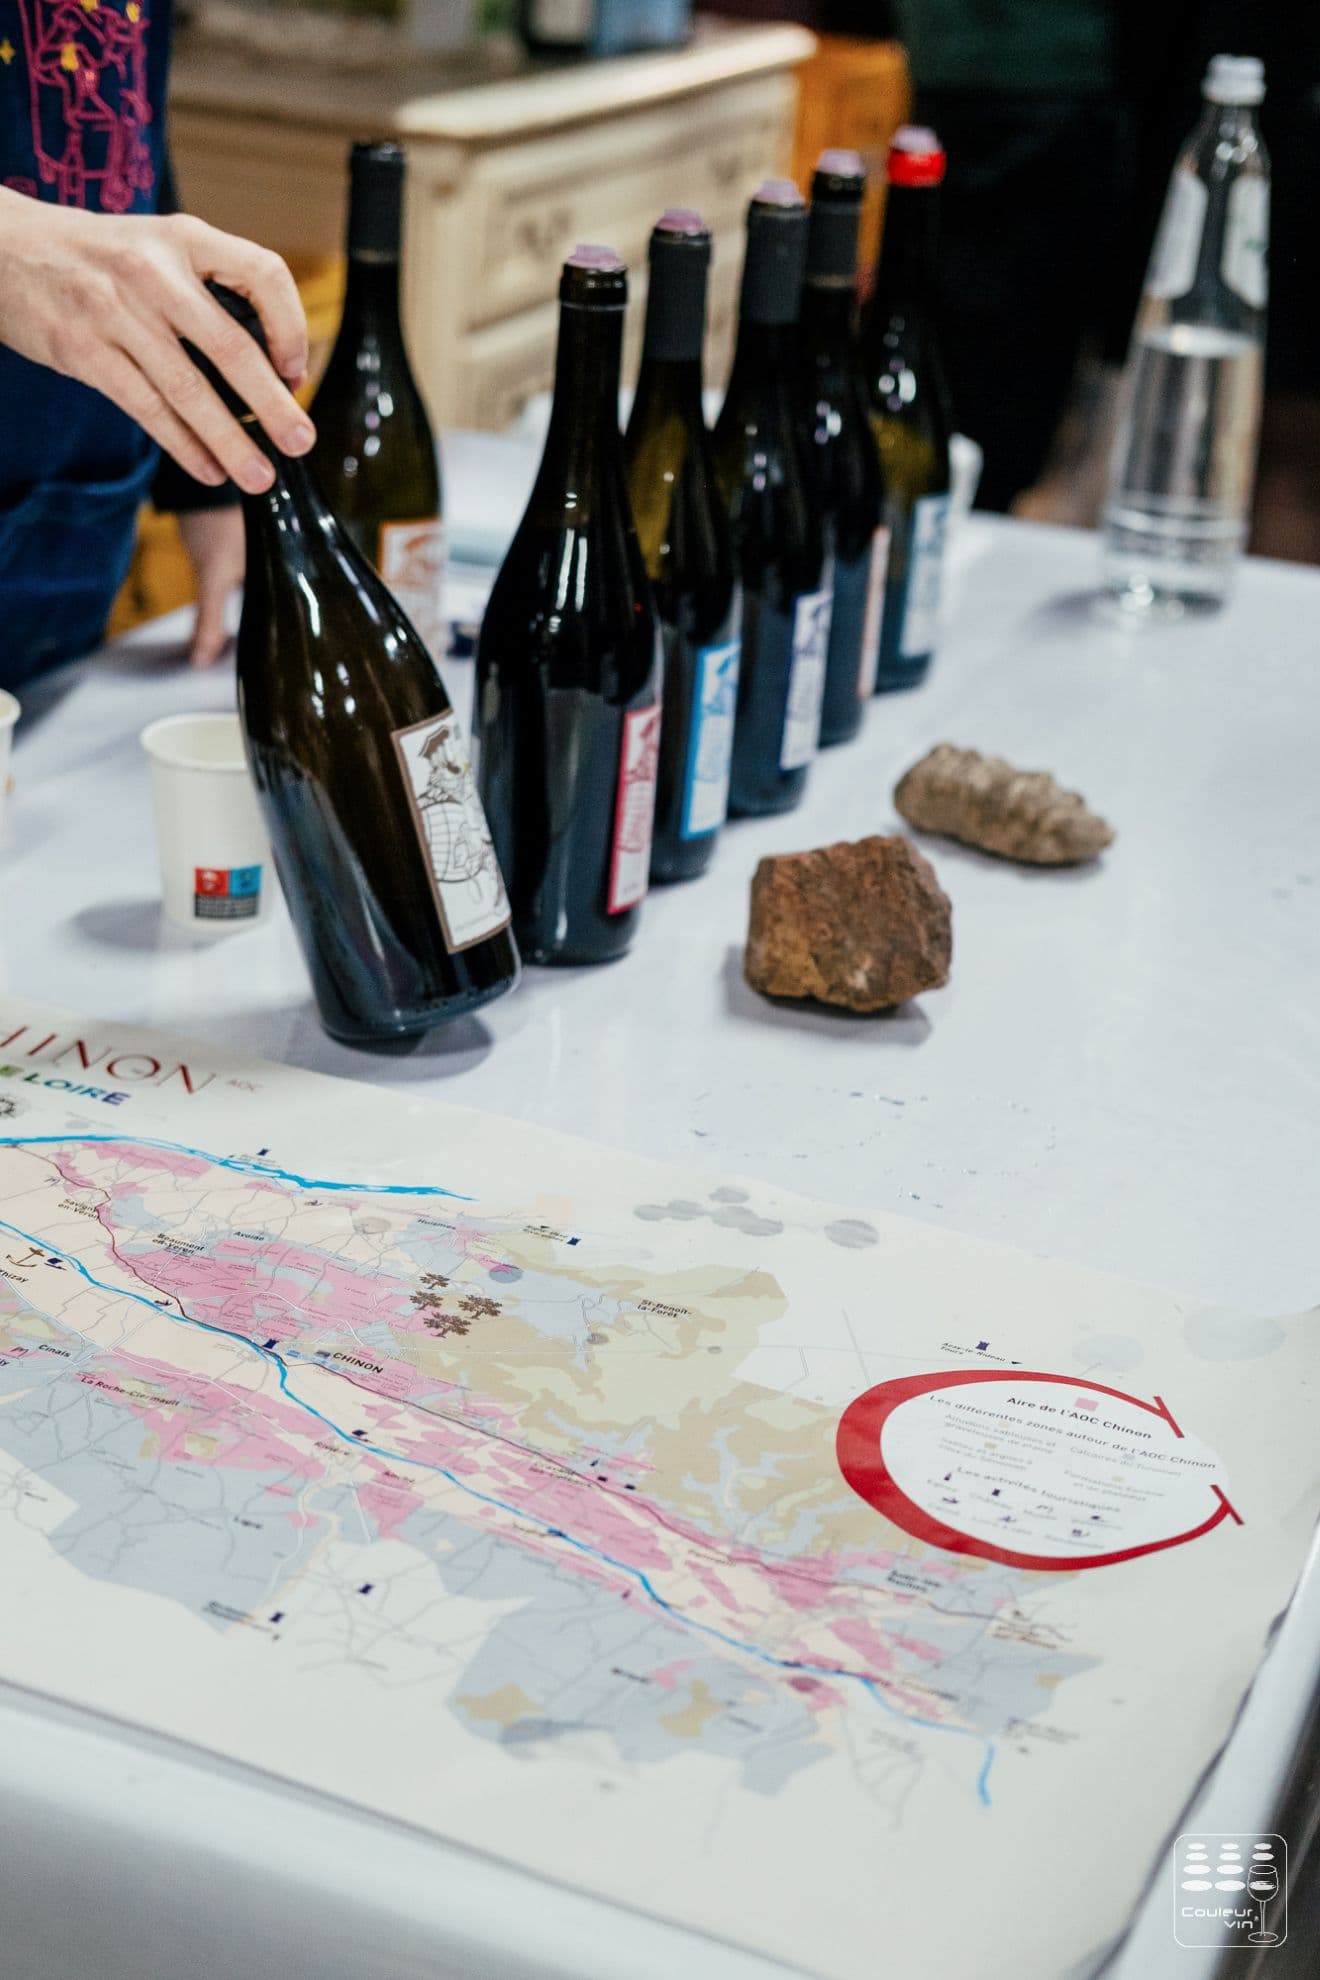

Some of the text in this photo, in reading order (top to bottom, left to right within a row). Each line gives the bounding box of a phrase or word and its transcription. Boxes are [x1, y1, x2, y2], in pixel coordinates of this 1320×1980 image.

[23, 1072, 131, 1106] LOIRE
[38, 1344, 72, 1358] Cinais
[332, 1352, 384, 1374] CHINON
[80, 1376, 94, 1384] La
[930, 1395, 1216, 1469] Les différentes zones autour de l'AOC Chinon
[1006, 1397, 1152, 1439] Aire de l'AOC Chinon
